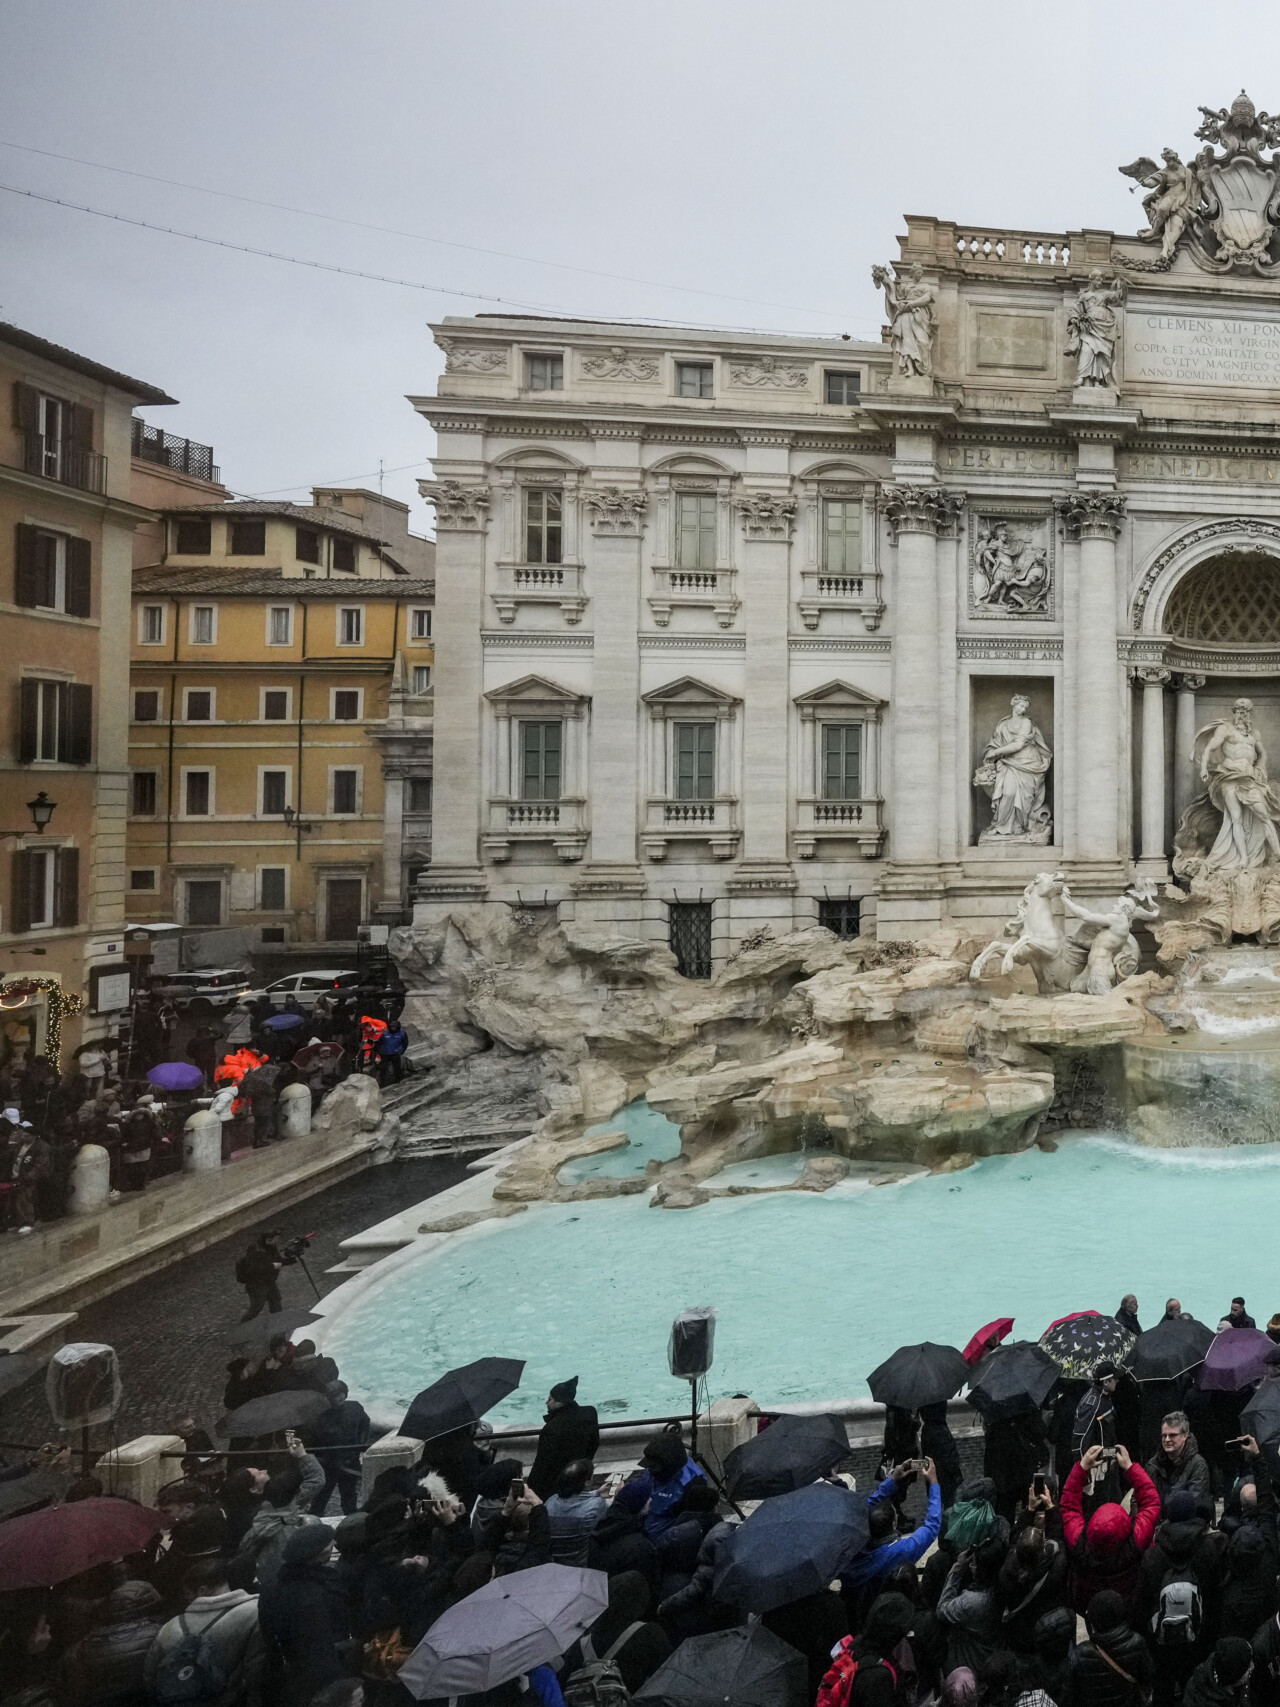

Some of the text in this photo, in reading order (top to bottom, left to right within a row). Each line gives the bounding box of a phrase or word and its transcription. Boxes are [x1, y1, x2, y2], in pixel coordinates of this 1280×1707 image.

[1146, 317, 1214, 333] CLEMENS
[1134, 343, 1168, 354] COPIA
[1172, 345, 1186, 355] ET
[1162, 356, 1199, 367] CVLTV
[1206, 359, 1269, 372] MAGNIFICO
[1139, 367, 1173, 378] ANNO
[1176, 369, 1218, 381] DOMINI
[945, 447, 1074, 472] PERFECIT
